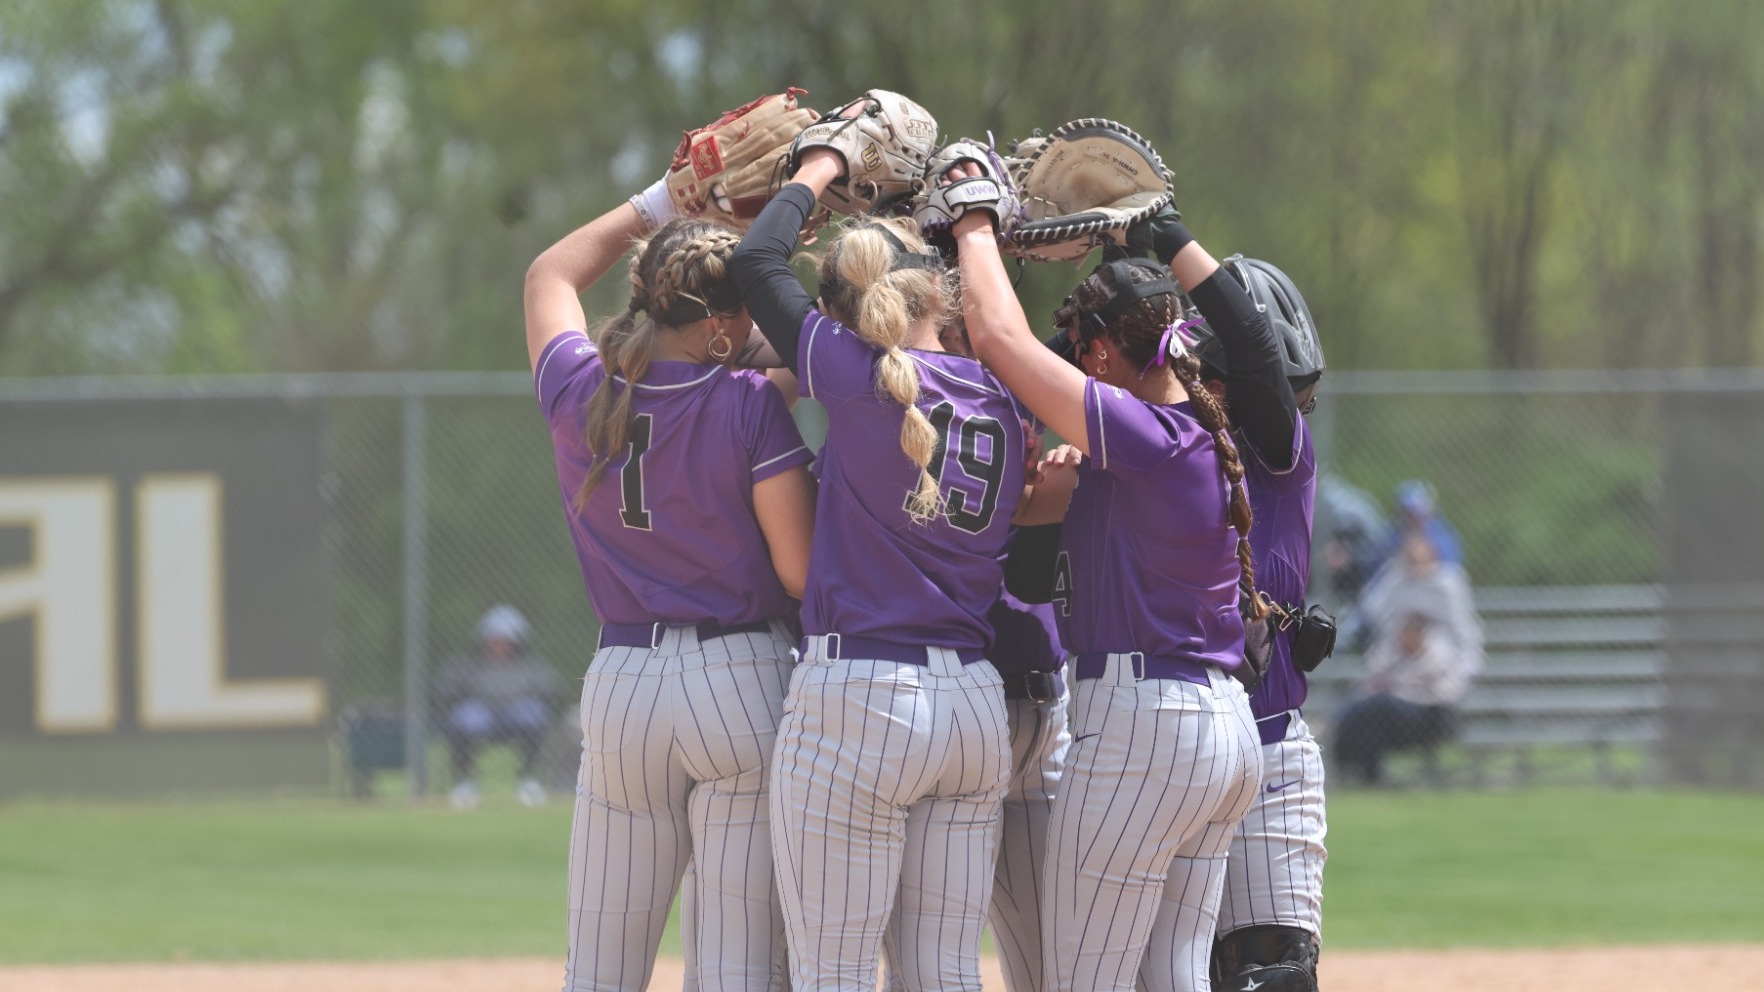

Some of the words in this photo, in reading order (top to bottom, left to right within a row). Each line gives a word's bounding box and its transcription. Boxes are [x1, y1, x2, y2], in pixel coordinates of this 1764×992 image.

[966, 186, 996, 196] UWW
[619, 412, 653, 531] 1
[902, 400, 1007, 535] 19
